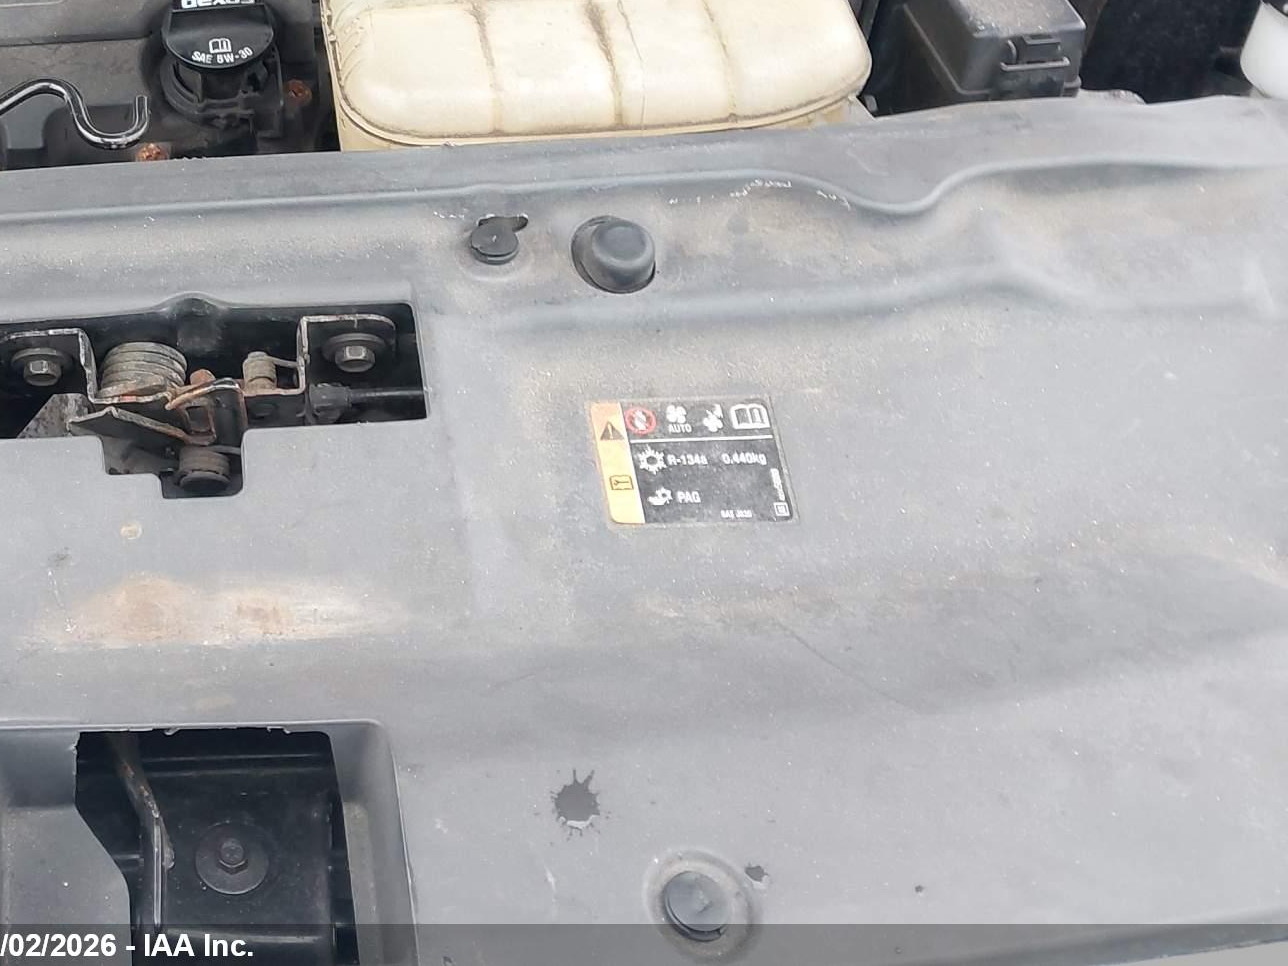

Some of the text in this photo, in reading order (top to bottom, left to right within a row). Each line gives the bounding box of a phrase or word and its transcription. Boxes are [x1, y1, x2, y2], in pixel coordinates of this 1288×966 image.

[192, 47, 253, 64] SAE 5W-30
[668, 424, 692, 433] AUTO
[667, 454, 708, 465] R-134a
[676, 490, 701, 503] PAG
